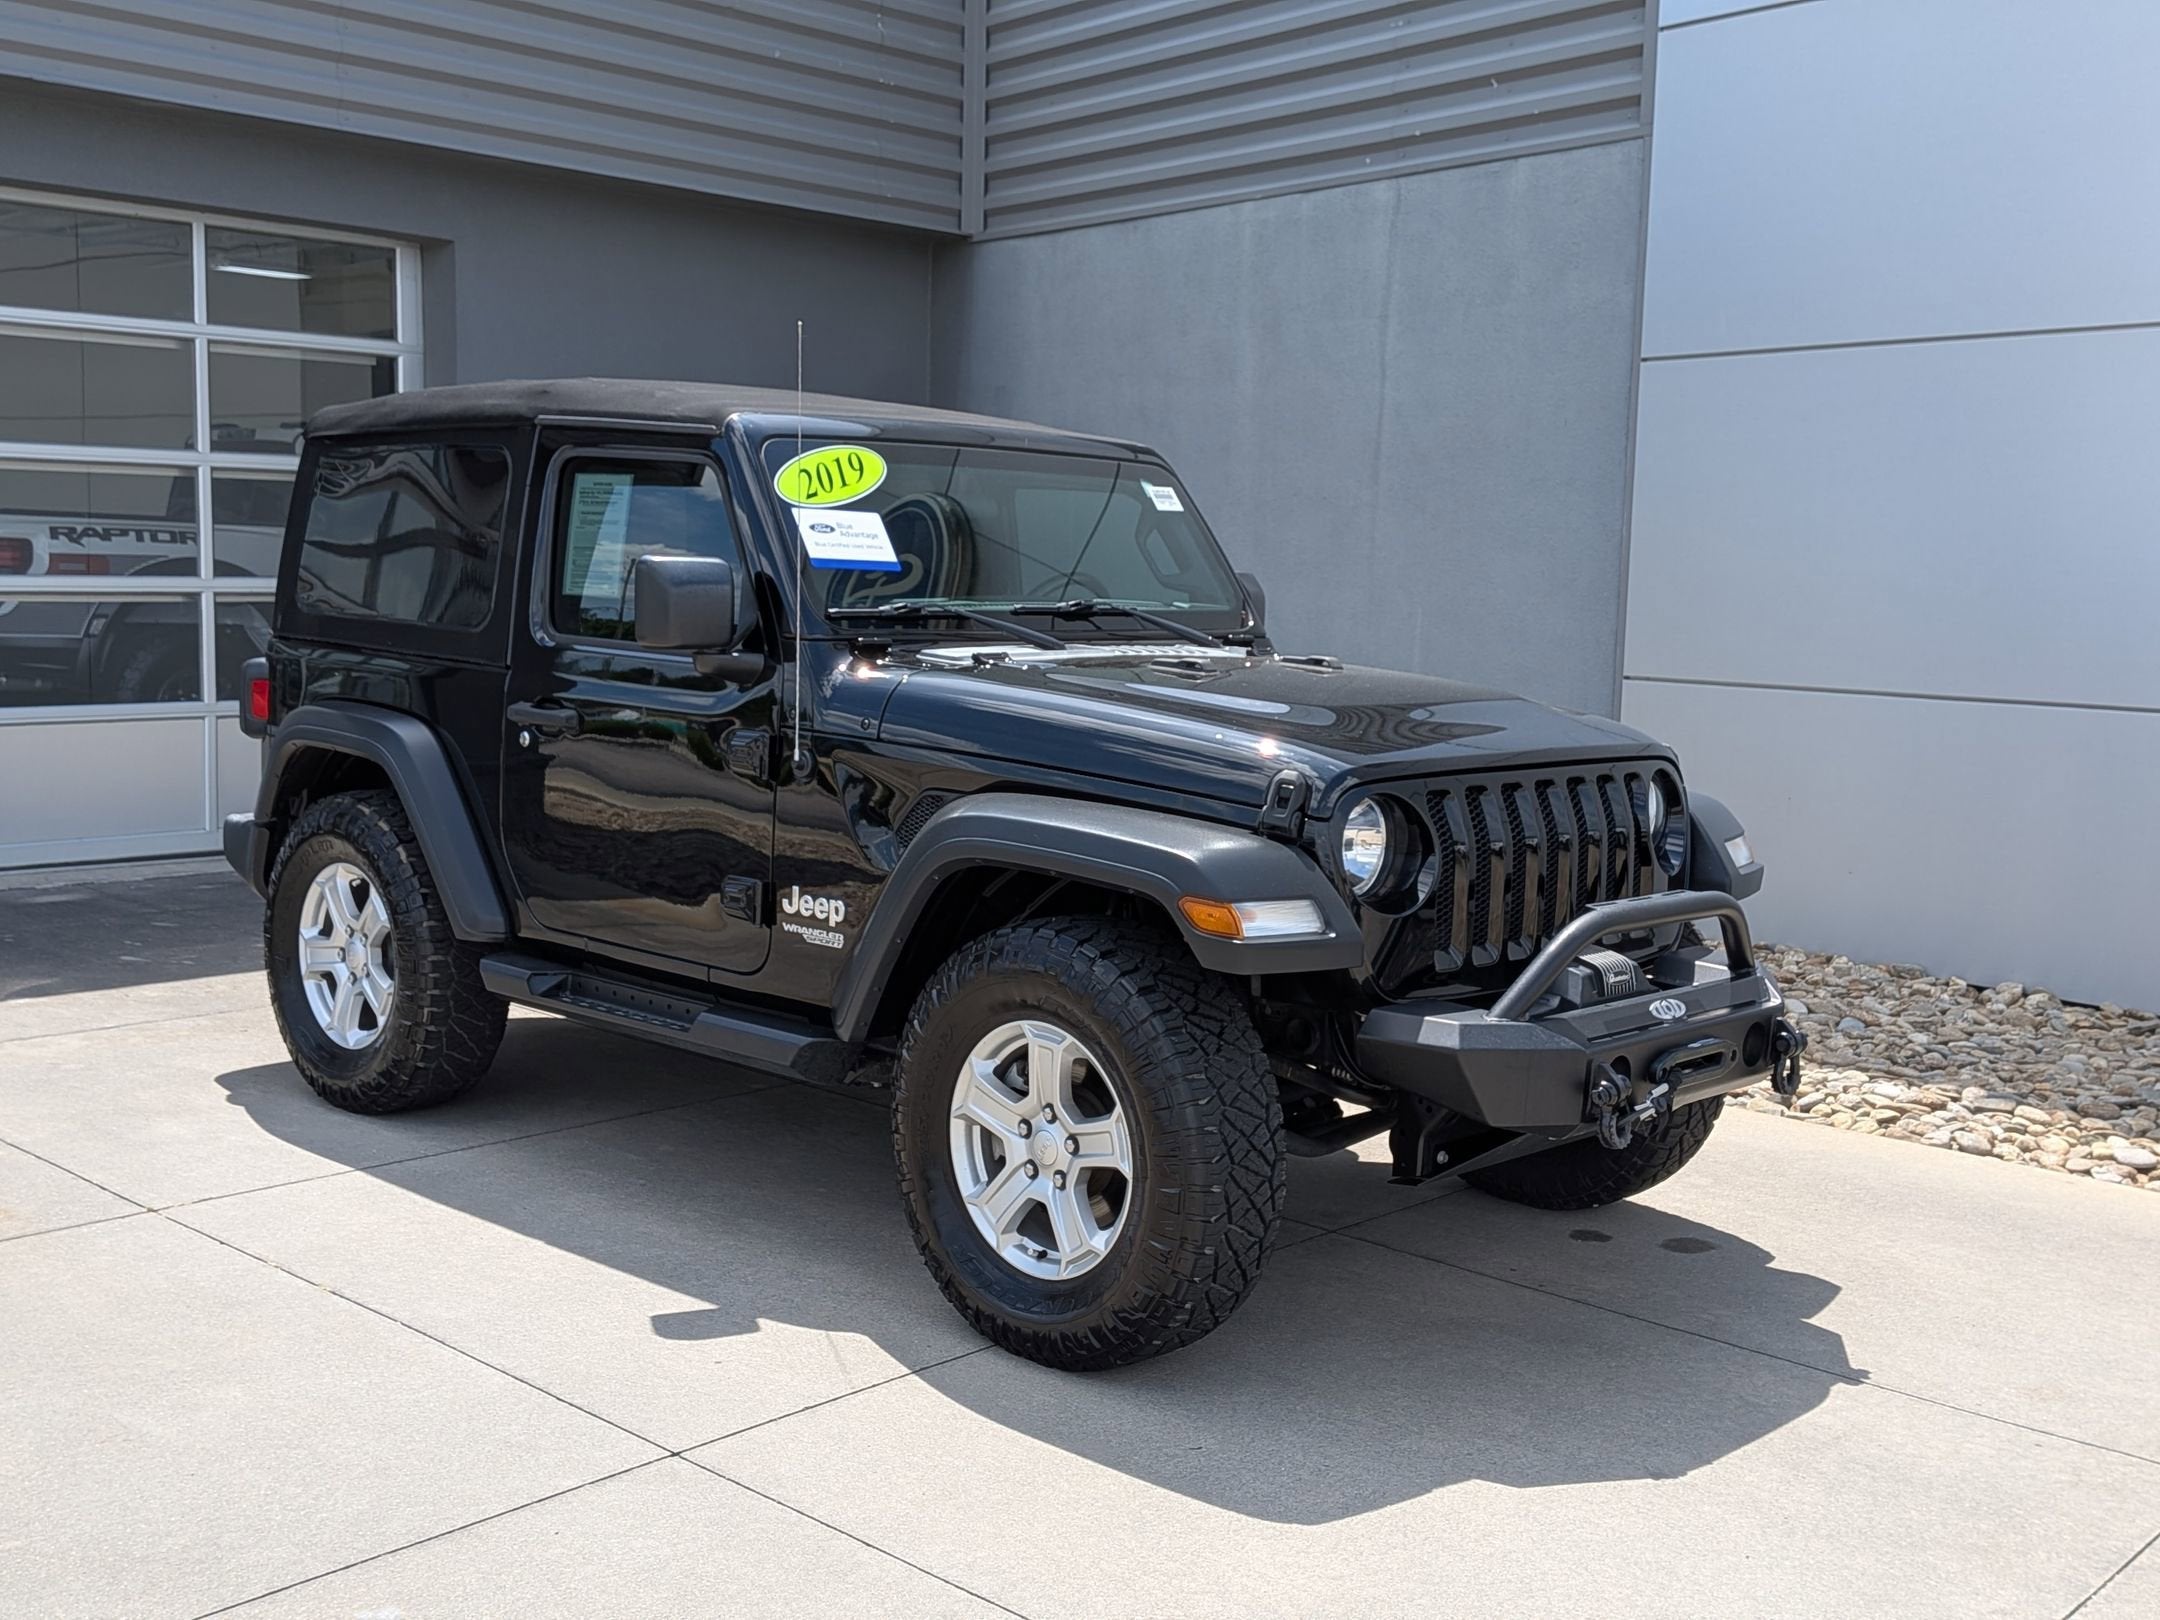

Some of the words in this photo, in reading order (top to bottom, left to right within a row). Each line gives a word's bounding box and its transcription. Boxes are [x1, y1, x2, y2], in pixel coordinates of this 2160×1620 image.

[799, 452, 865, 500] 2019
[836, 521, 853, 530] Blue
[839, 529, 879, 541] Advantage
[49, 526, 198, 547] RAPTOR
[782, 885, 845, 927] Jeep
[782, 921, 844, 942] WRANGLER
[806, 935, 844, 948] SPORT
